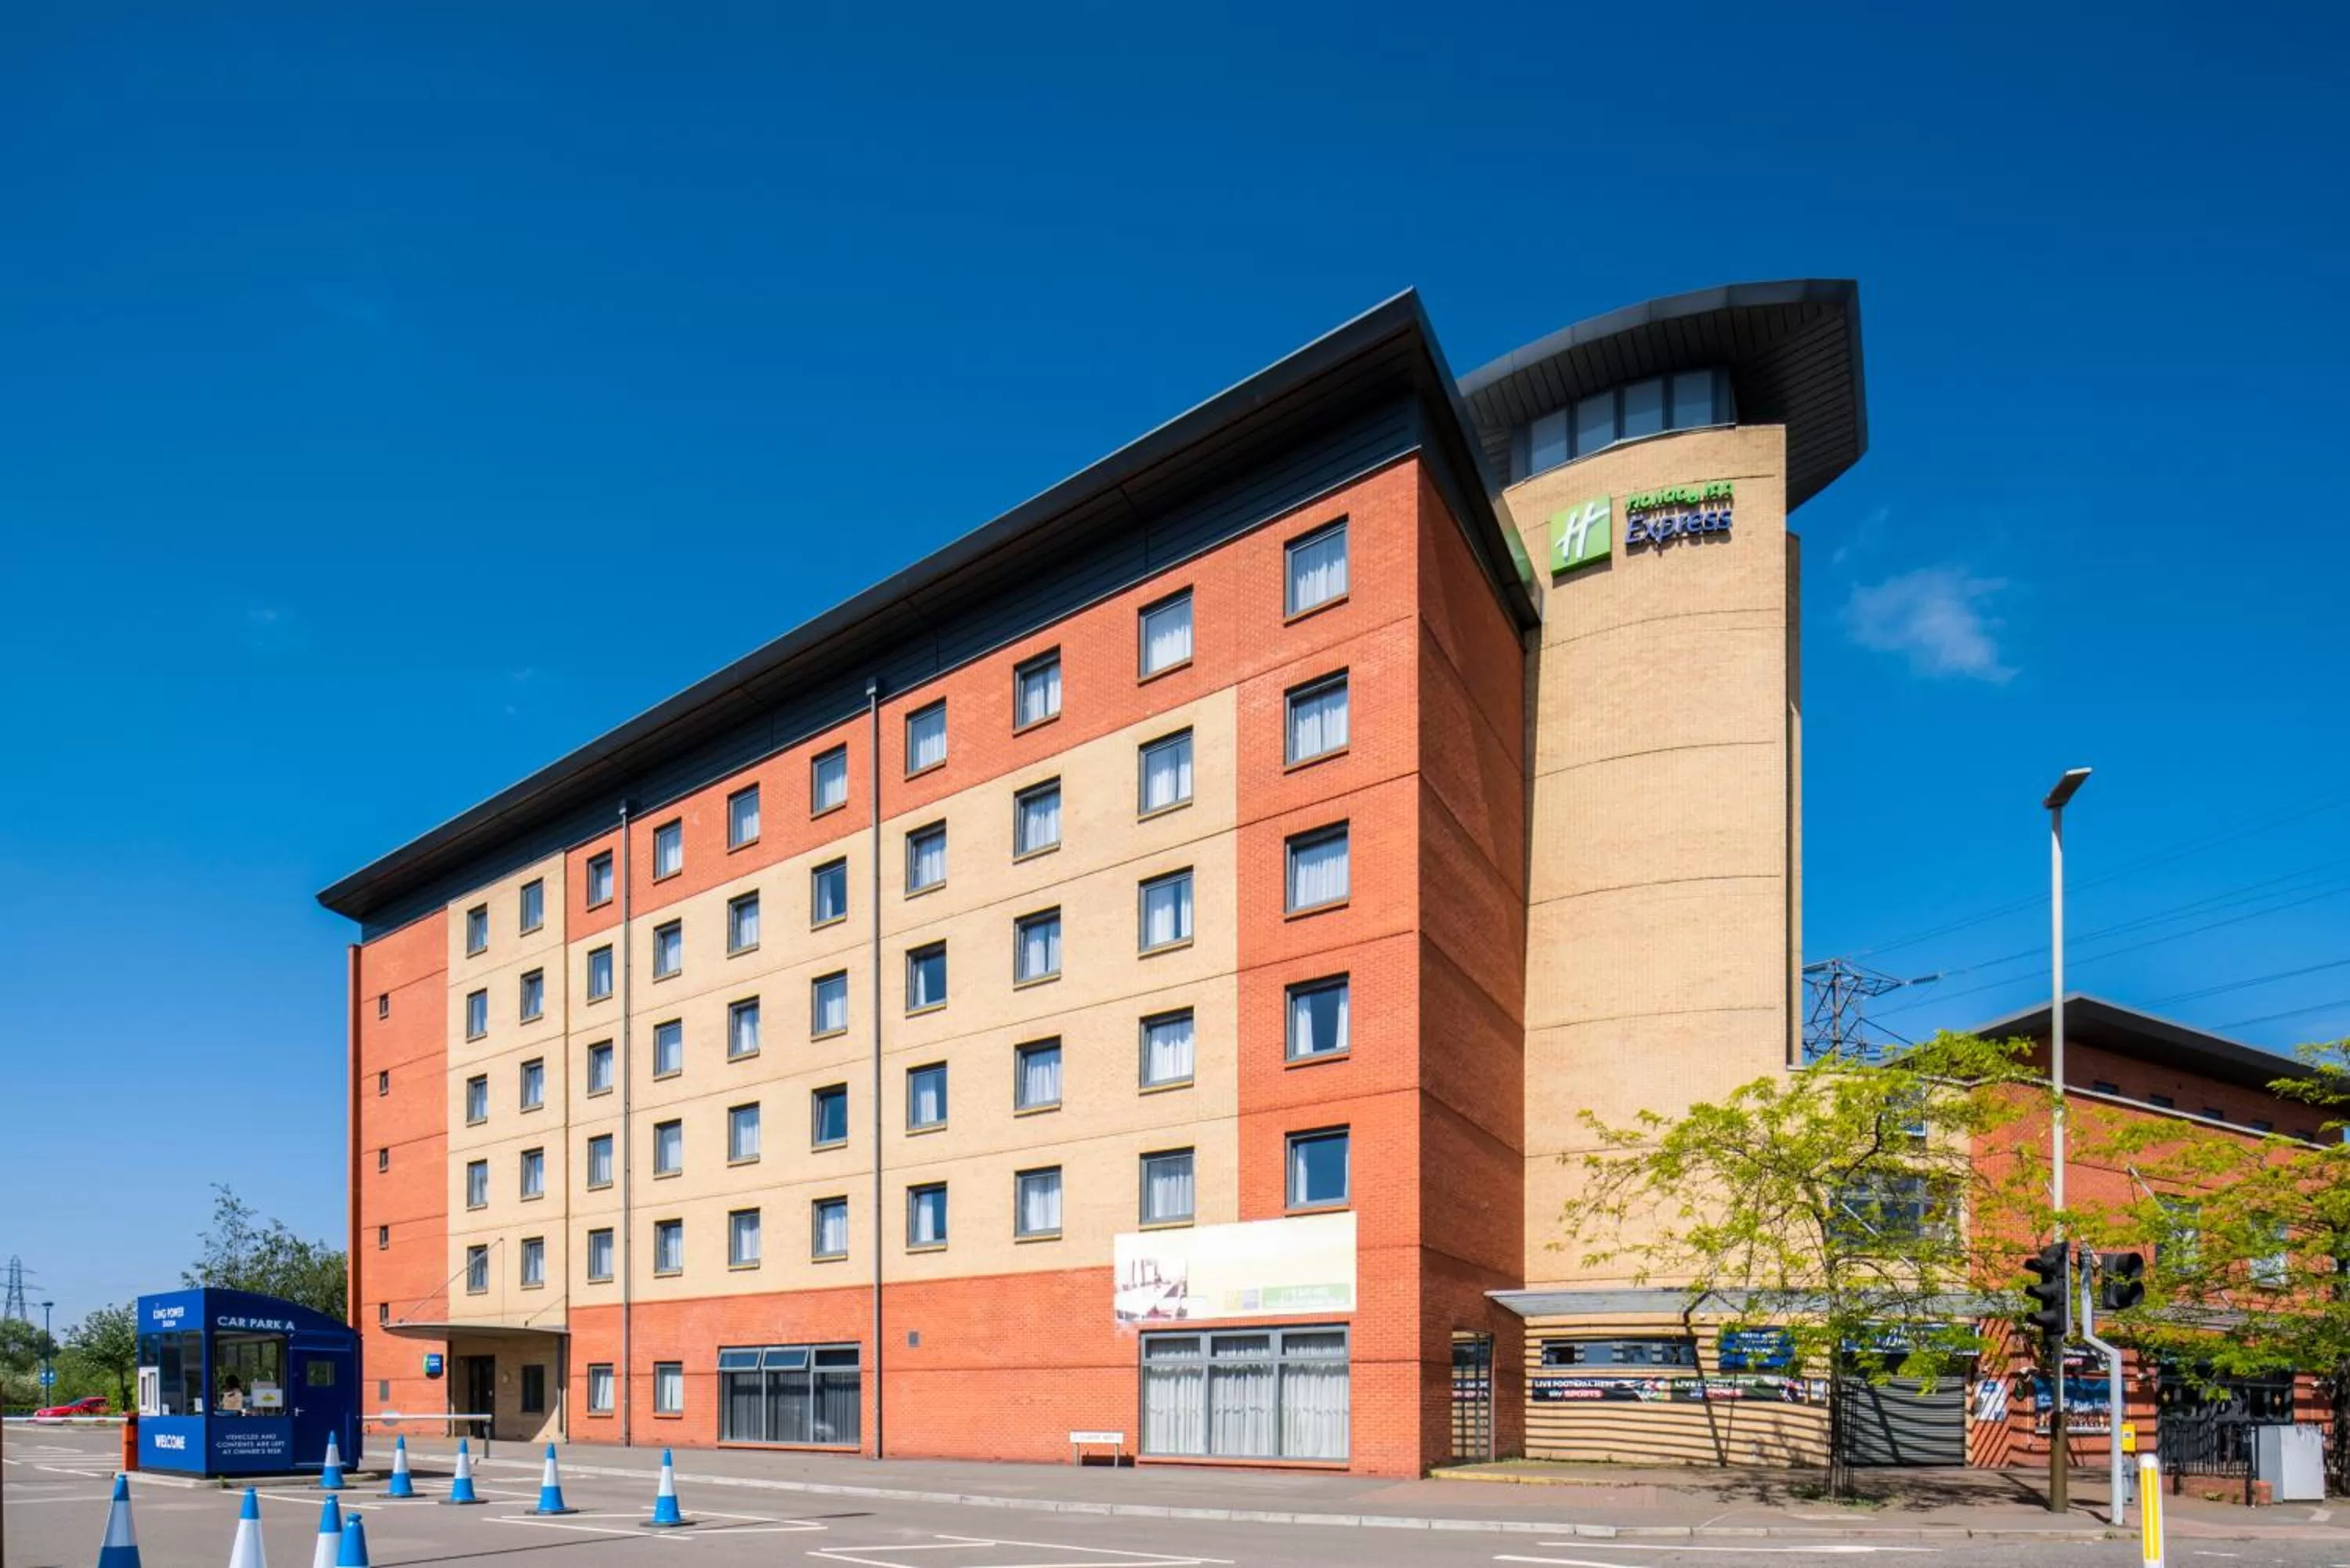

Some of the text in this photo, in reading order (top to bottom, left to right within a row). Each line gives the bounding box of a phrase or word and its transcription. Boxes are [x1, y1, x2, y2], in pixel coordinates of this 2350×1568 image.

[1625, 481, 1734, 511] Holiday Inn
[1625, 508, 1731, 544] Express
[217, 1316, 295, 1331] CAR PARK A
[1535, 1379, 1552, 1388] LIVE
[1553, 1379, 1594, 1388] FOOTBALL
[1564, 1389, 1603, 1398] SPORTS
[154, 1434, 186, 1450] WELCOME
